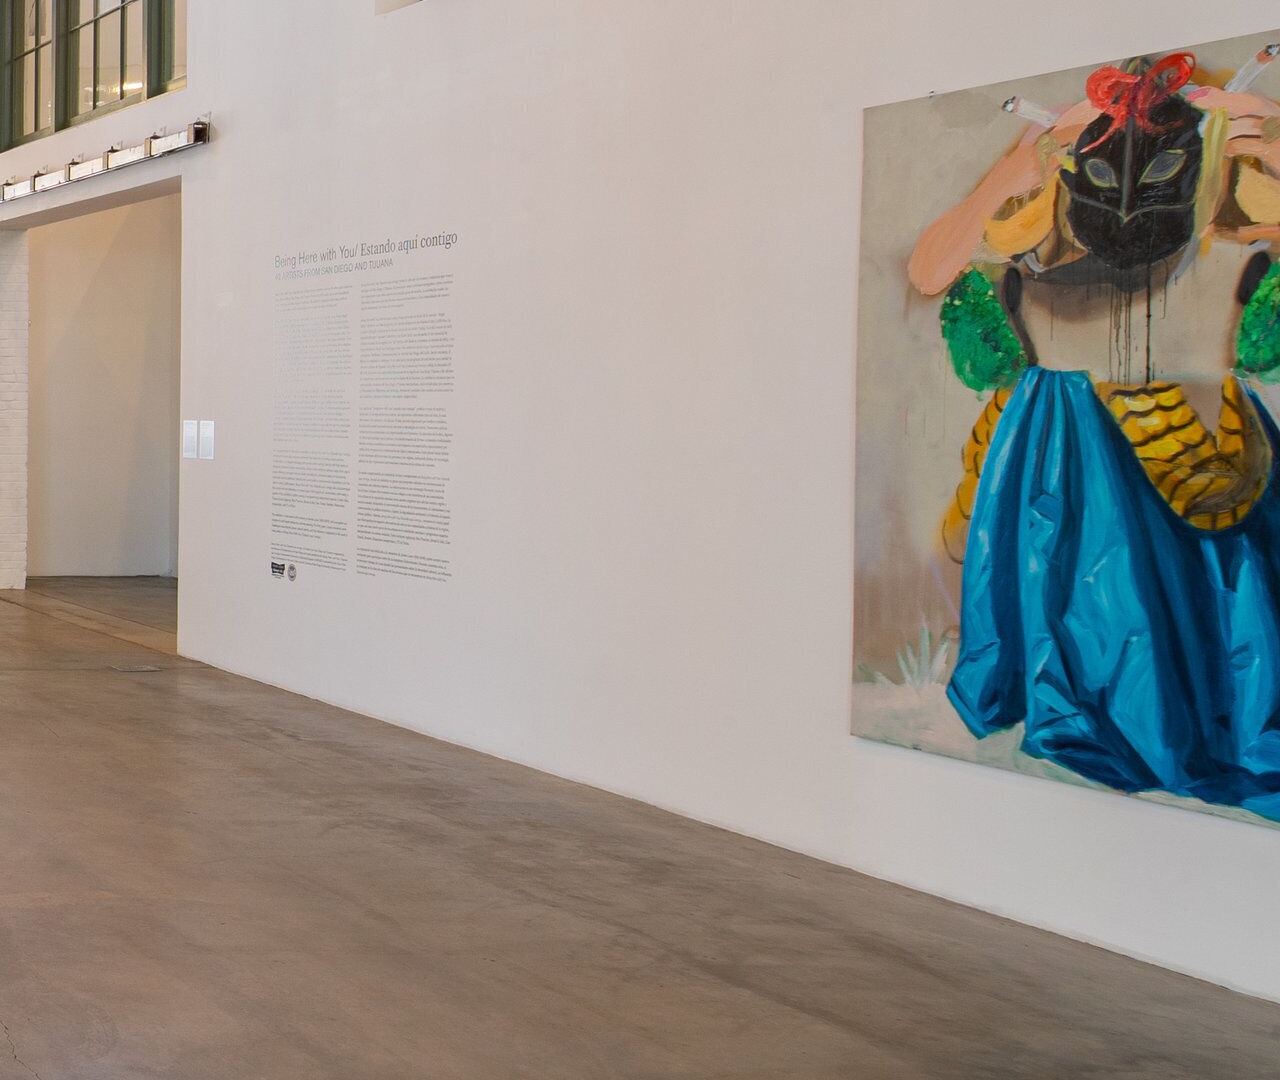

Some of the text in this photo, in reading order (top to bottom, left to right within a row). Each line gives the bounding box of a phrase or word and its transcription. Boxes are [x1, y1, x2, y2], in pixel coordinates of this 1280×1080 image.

[274, 230, 458, 269] Being Here with You/ Estando aquí contigo
[304, 267, 320, 277] FROM
[320, 265, 333, 275] SAN
[333, 262, 353, 274] DIEGO
[354, 260, 368, 271] AND
[369, 258, 393, 270] TIJUANA
